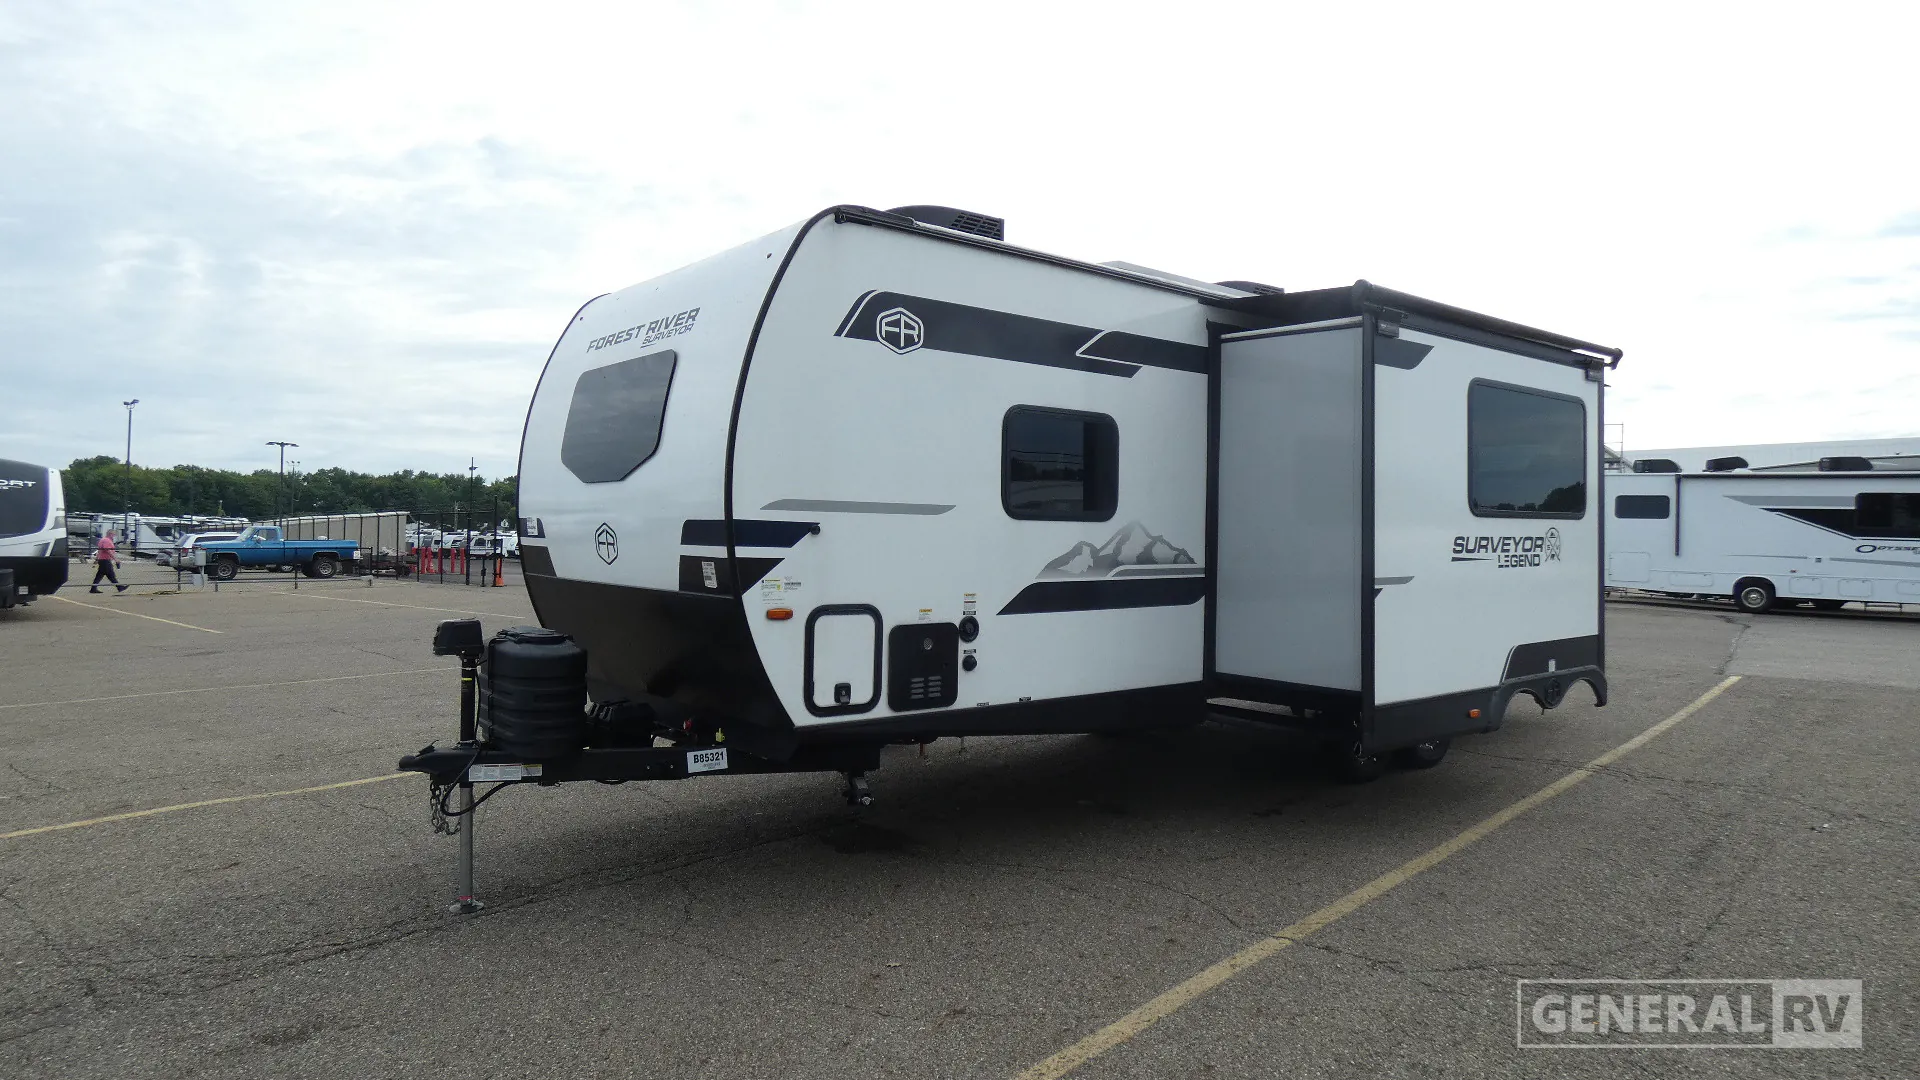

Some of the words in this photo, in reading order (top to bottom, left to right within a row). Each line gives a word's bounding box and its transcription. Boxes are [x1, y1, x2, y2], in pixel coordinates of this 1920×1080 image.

[586, 324, 647, 354] FOREST
[645, 307, 701, 336] RIVER
[641, 323, 695, 345] SURVEYOR
[1452, 535, 1545, 554] SURVEYOR
[1497, 553, 1541, 569] LEGEND
[693, 751, 724, 764] B85321
